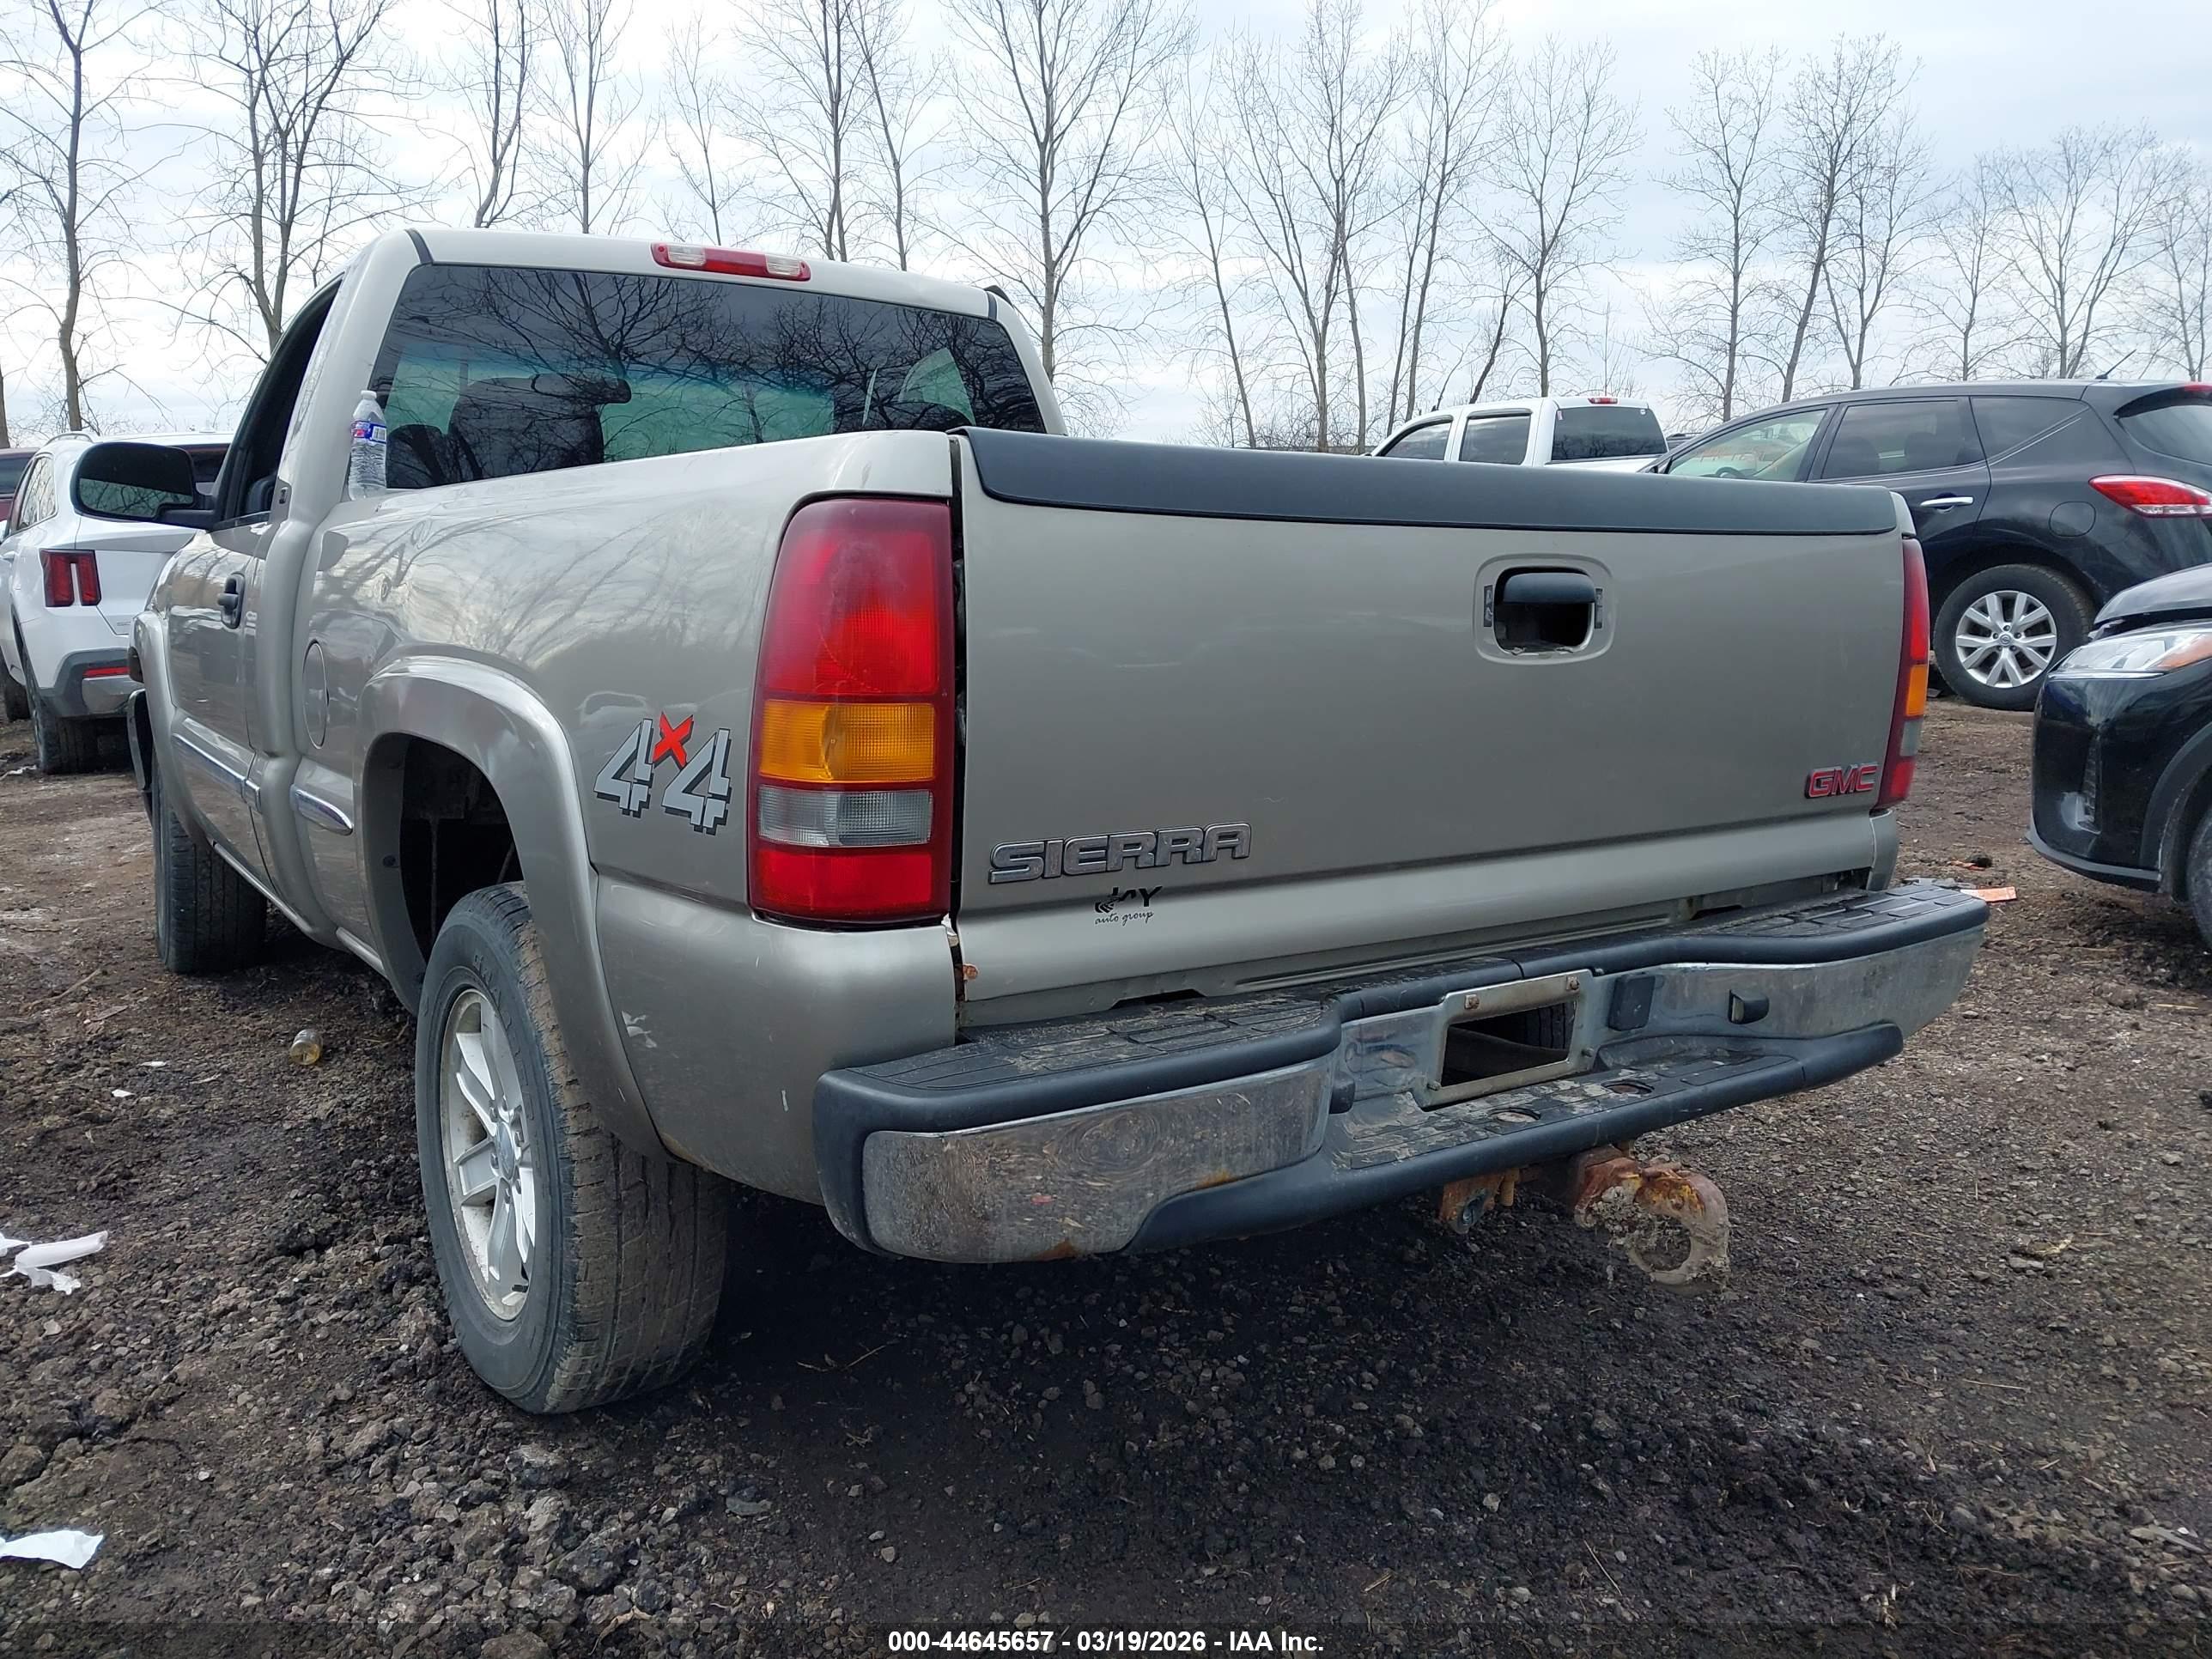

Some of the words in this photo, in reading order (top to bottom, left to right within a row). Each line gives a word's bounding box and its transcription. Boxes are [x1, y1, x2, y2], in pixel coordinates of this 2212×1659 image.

[1806, 763, 1878, 799] GMC
[989, 823, 1251, 884] SIERRA
[1094, 913, 1119, 925] auto
[1121, 911, 1154, 927] group
